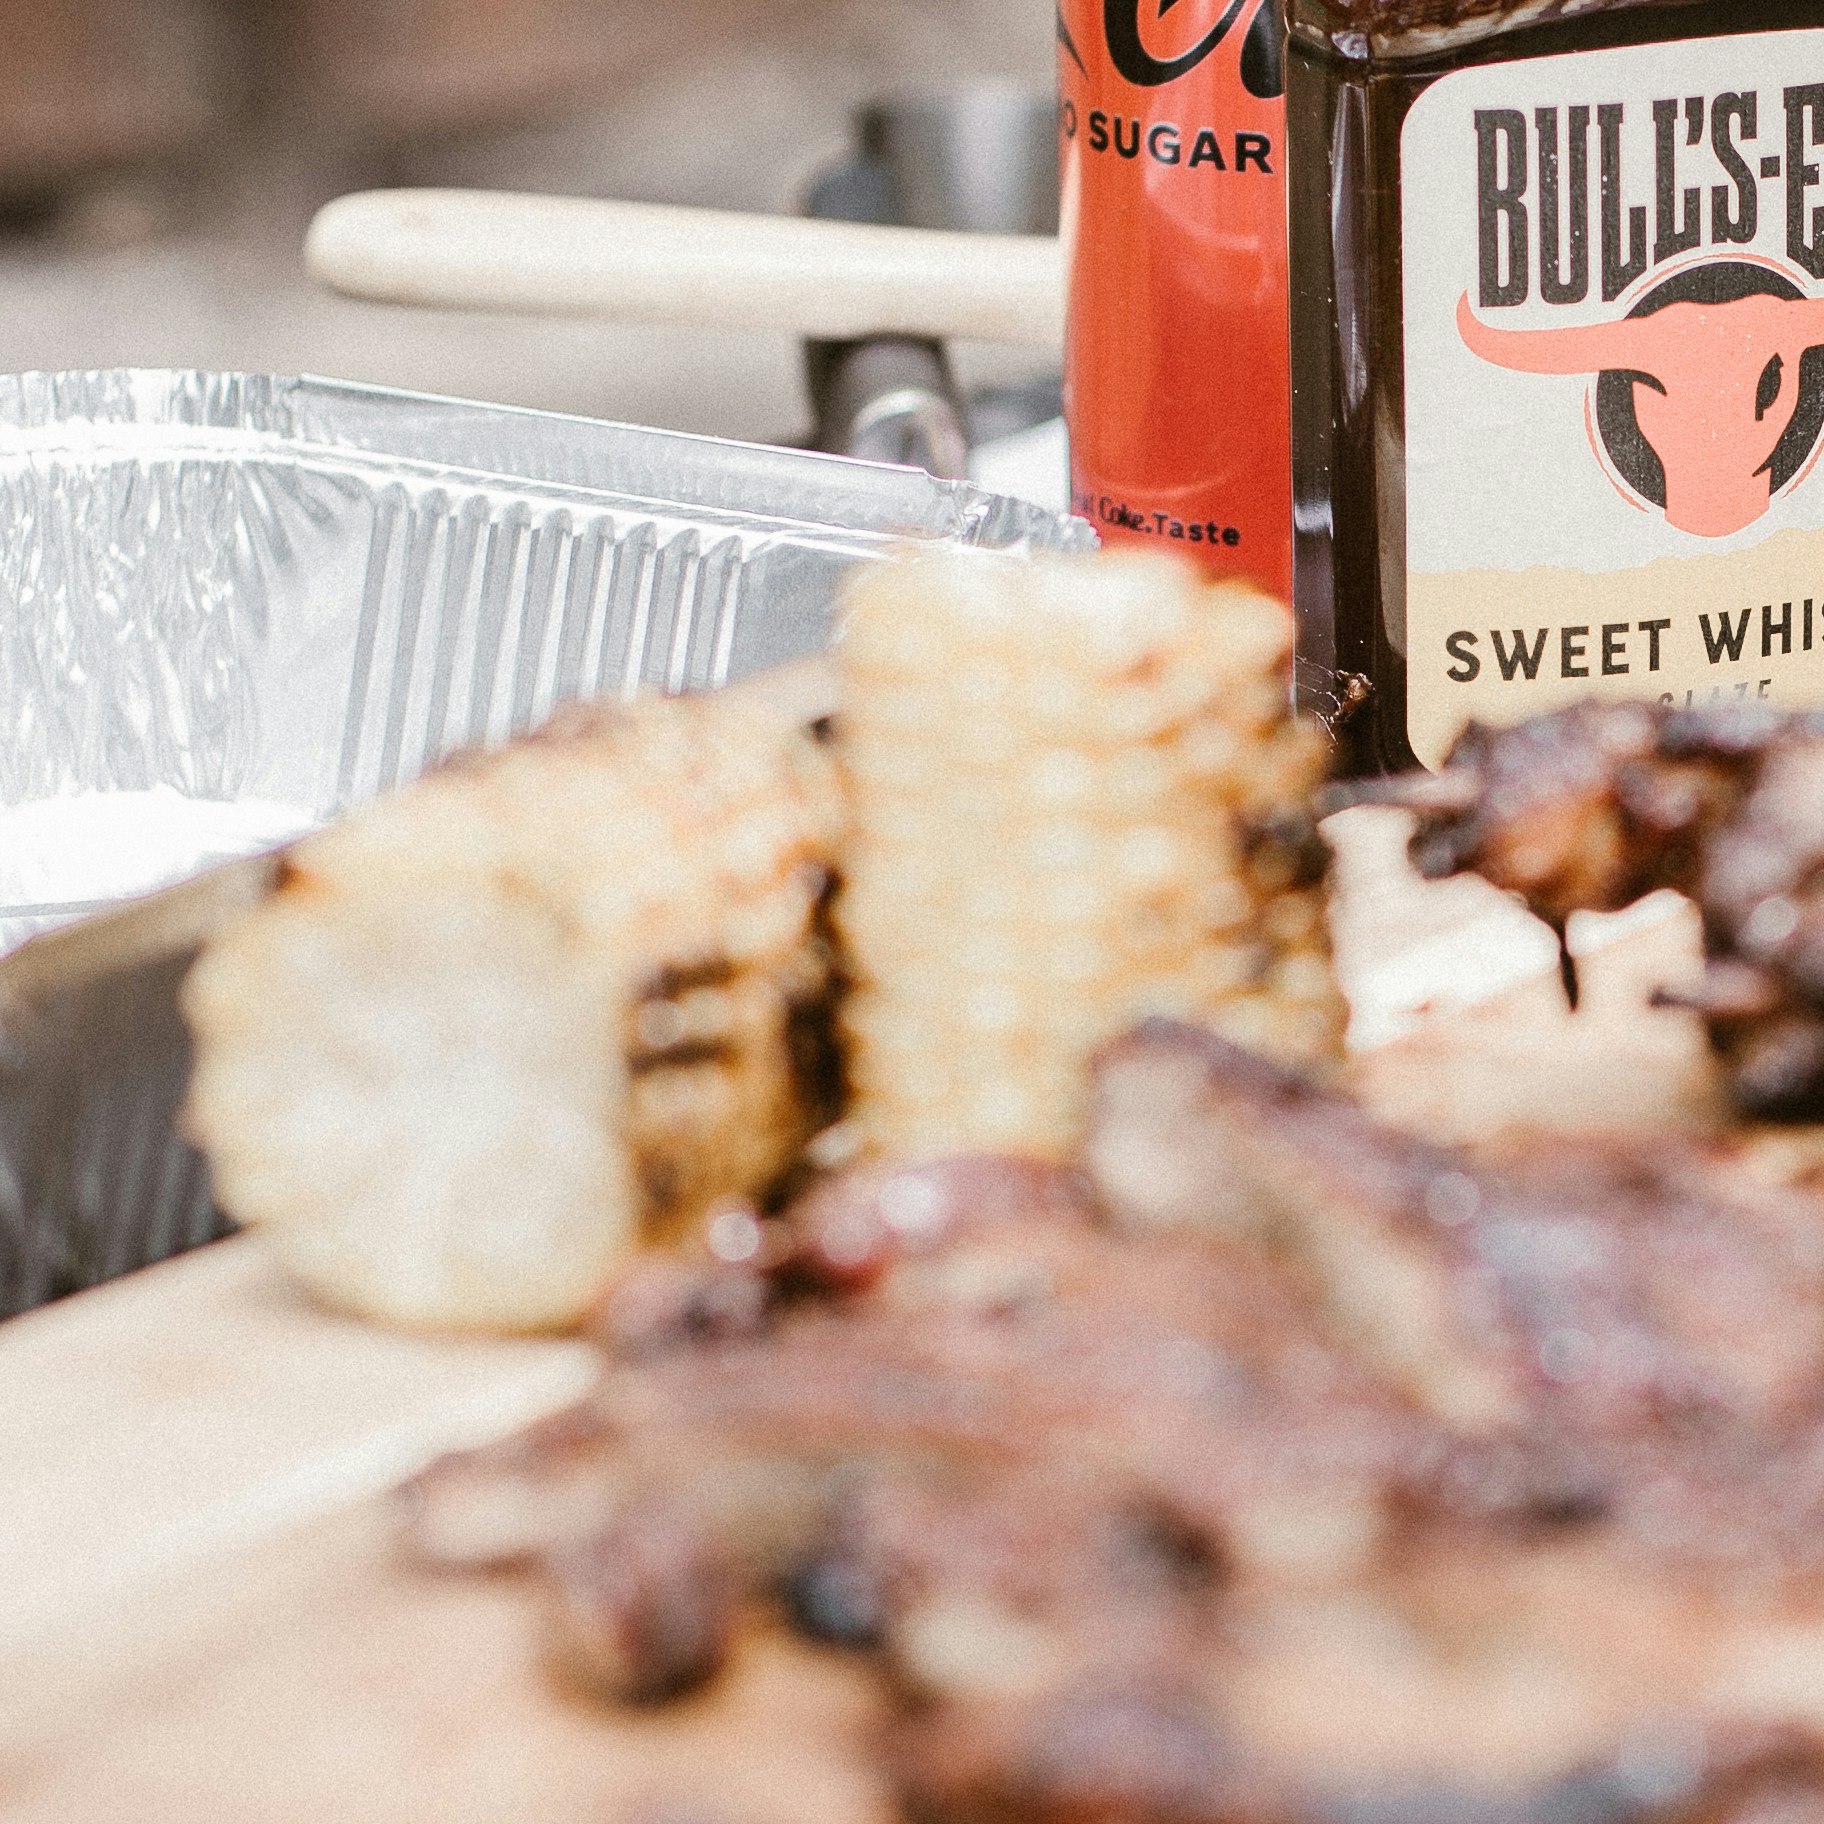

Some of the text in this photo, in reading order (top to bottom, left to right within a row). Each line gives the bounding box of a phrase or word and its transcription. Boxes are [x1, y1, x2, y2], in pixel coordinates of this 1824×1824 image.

[1088, 108, 1273, 174] SUGAR
[1153, 510, 1241, 546] Taste
[1445, 618, 1670, 683] SWEET
